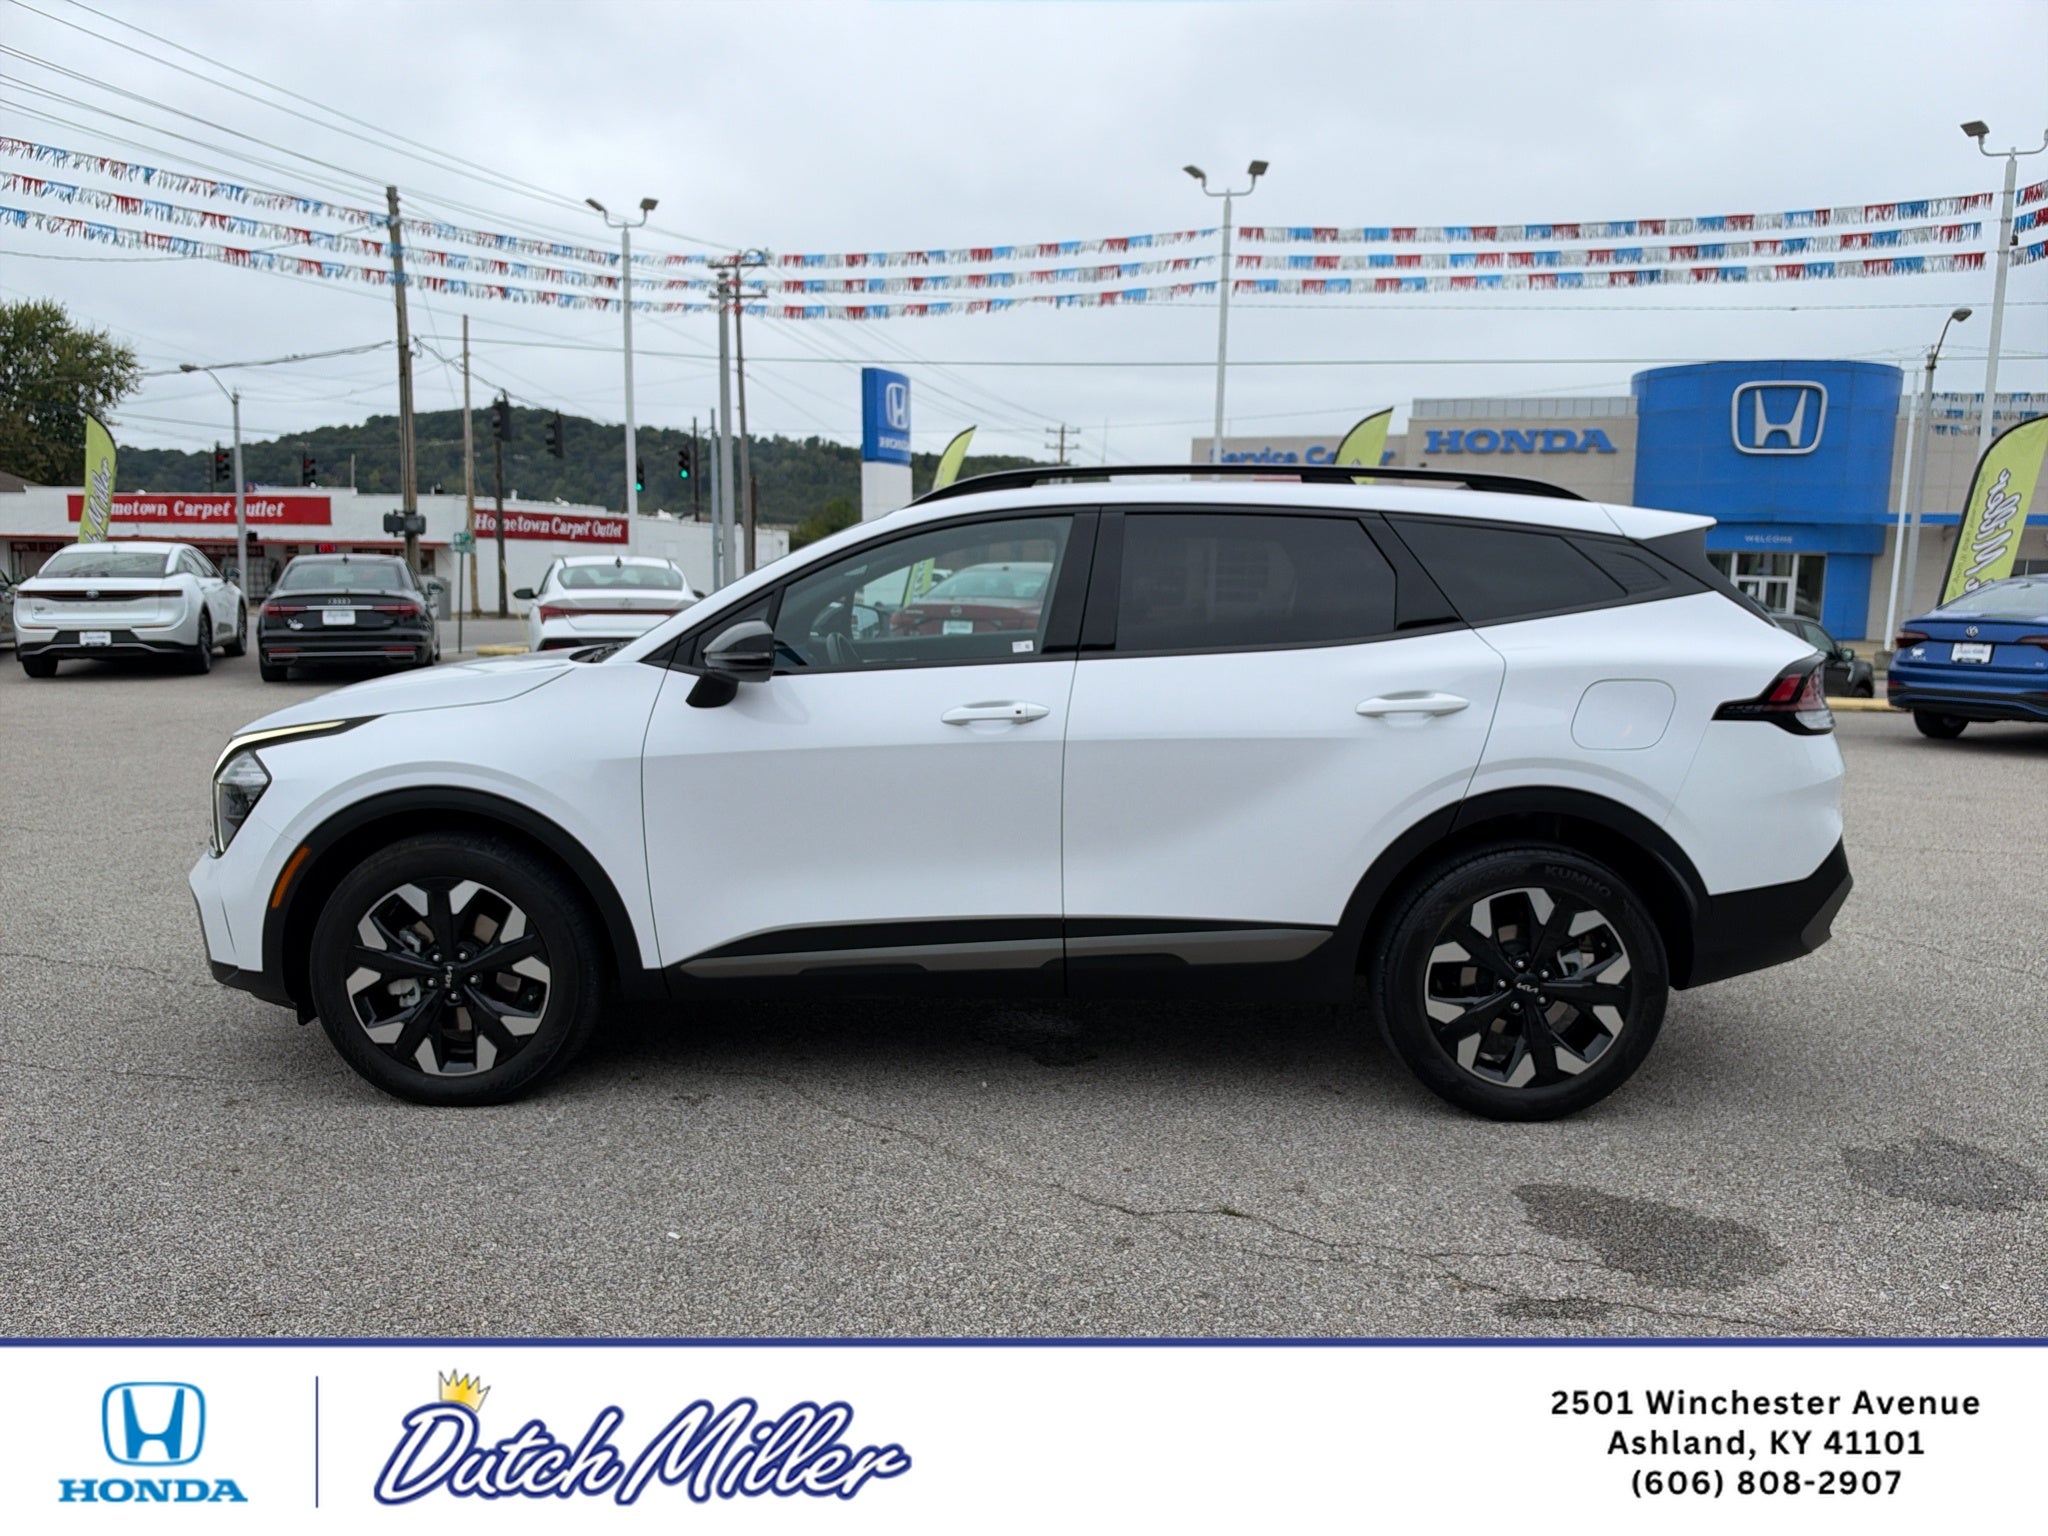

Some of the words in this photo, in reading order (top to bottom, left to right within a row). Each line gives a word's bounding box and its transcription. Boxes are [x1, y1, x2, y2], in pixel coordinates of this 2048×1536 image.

[1425, 428, 1618, 454] HONDA
[1305, 446, 1396, 466] Cer
[111, 501, 168, 517] metown
[173, 499, 231, 521] Carpet
[235, 500, 285, 518] utlet
[551, 516, 590, 540] Carpet
[592, 520, 622, 538] Outlet
